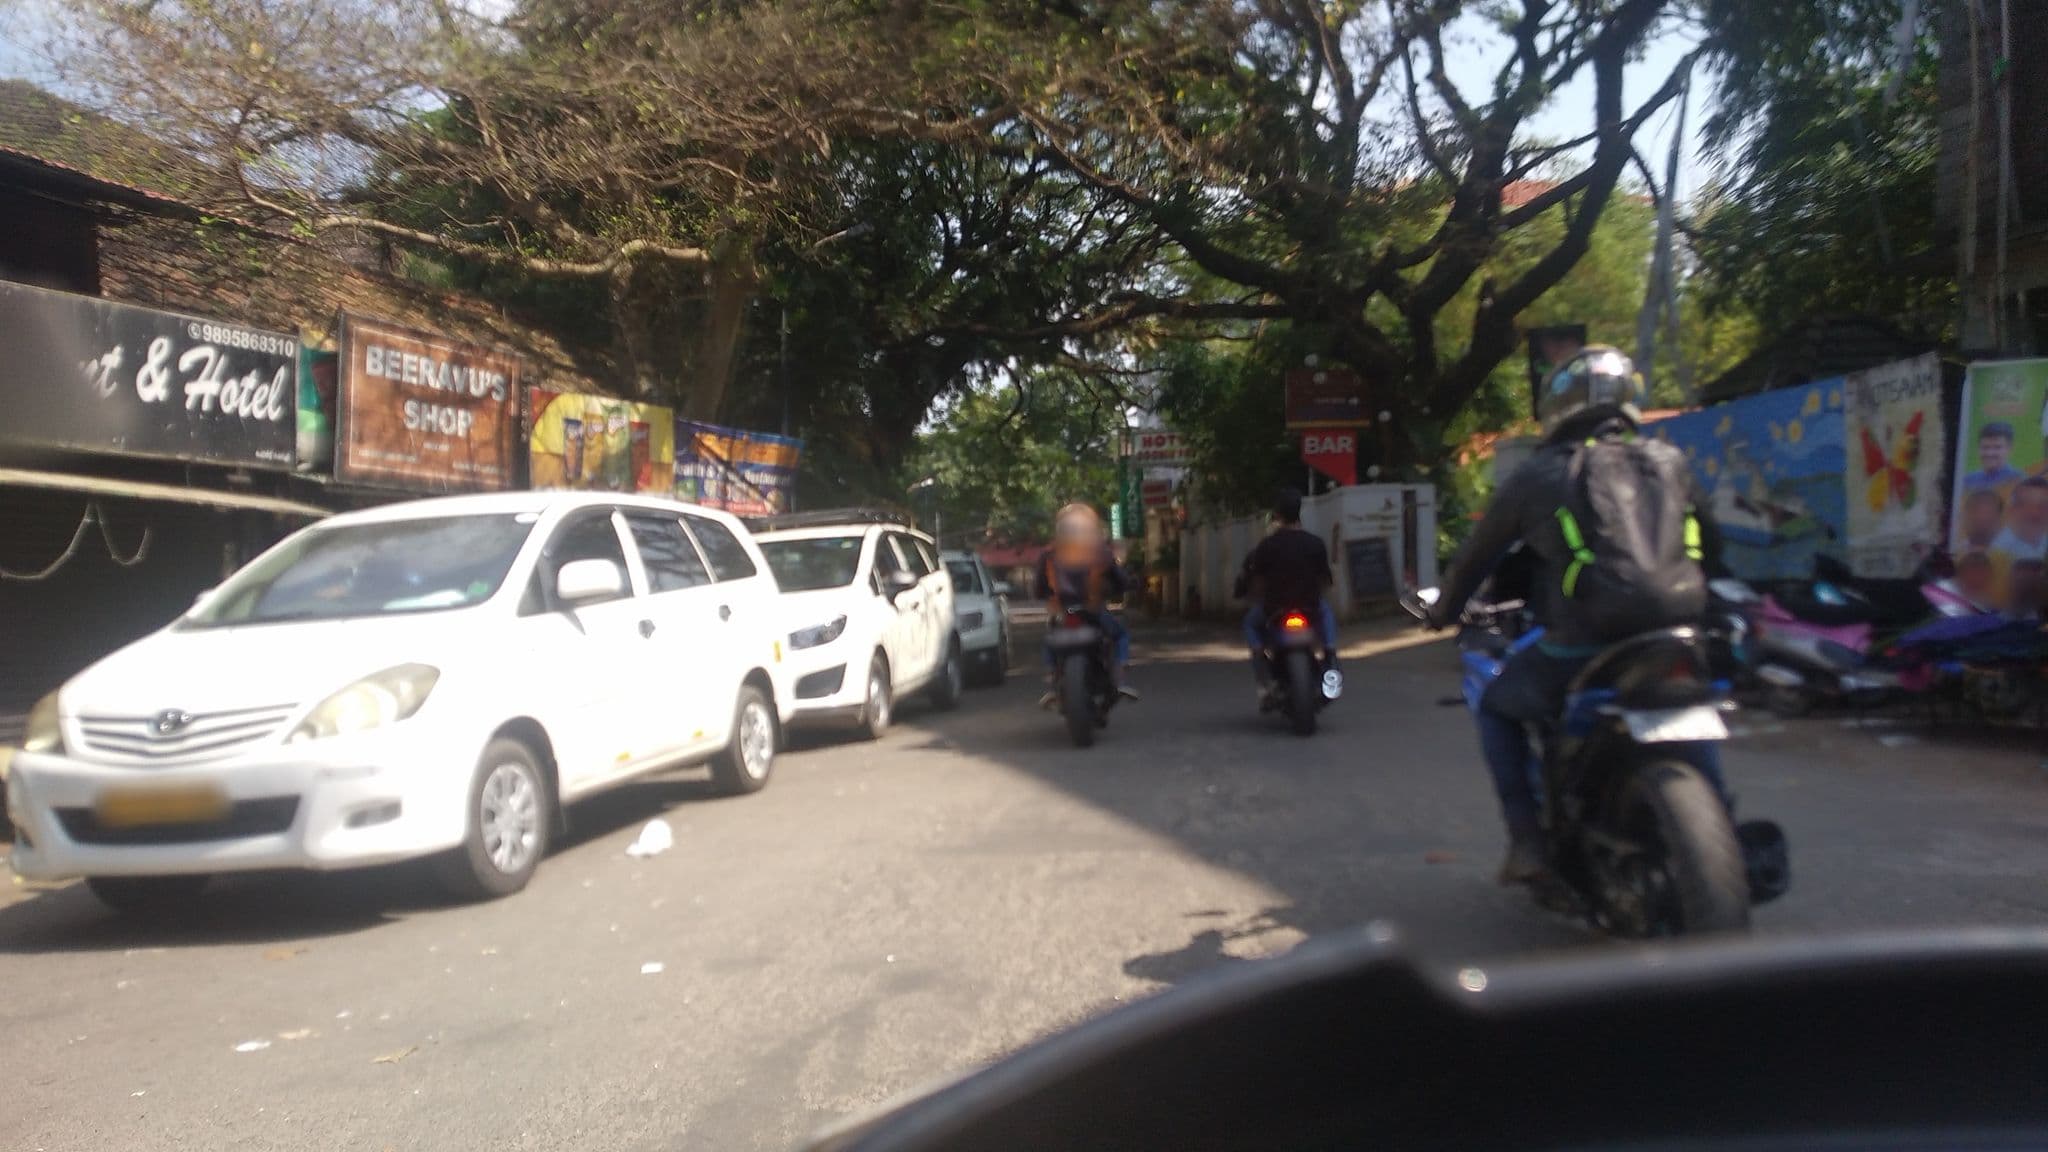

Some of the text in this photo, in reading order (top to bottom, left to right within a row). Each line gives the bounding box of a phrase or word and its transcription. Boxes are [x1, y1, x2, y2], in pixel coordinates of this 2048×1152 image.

[201, 324, 294, 358] 9895868310
[136, 336, 173, 402] &
[178, 346, 286, 421] Hotel
[366, 344, 506, 402] BEERAVU'S
[403, 399, 473, 438] SHOP
[1304, 436, 1353, 455] BAR
